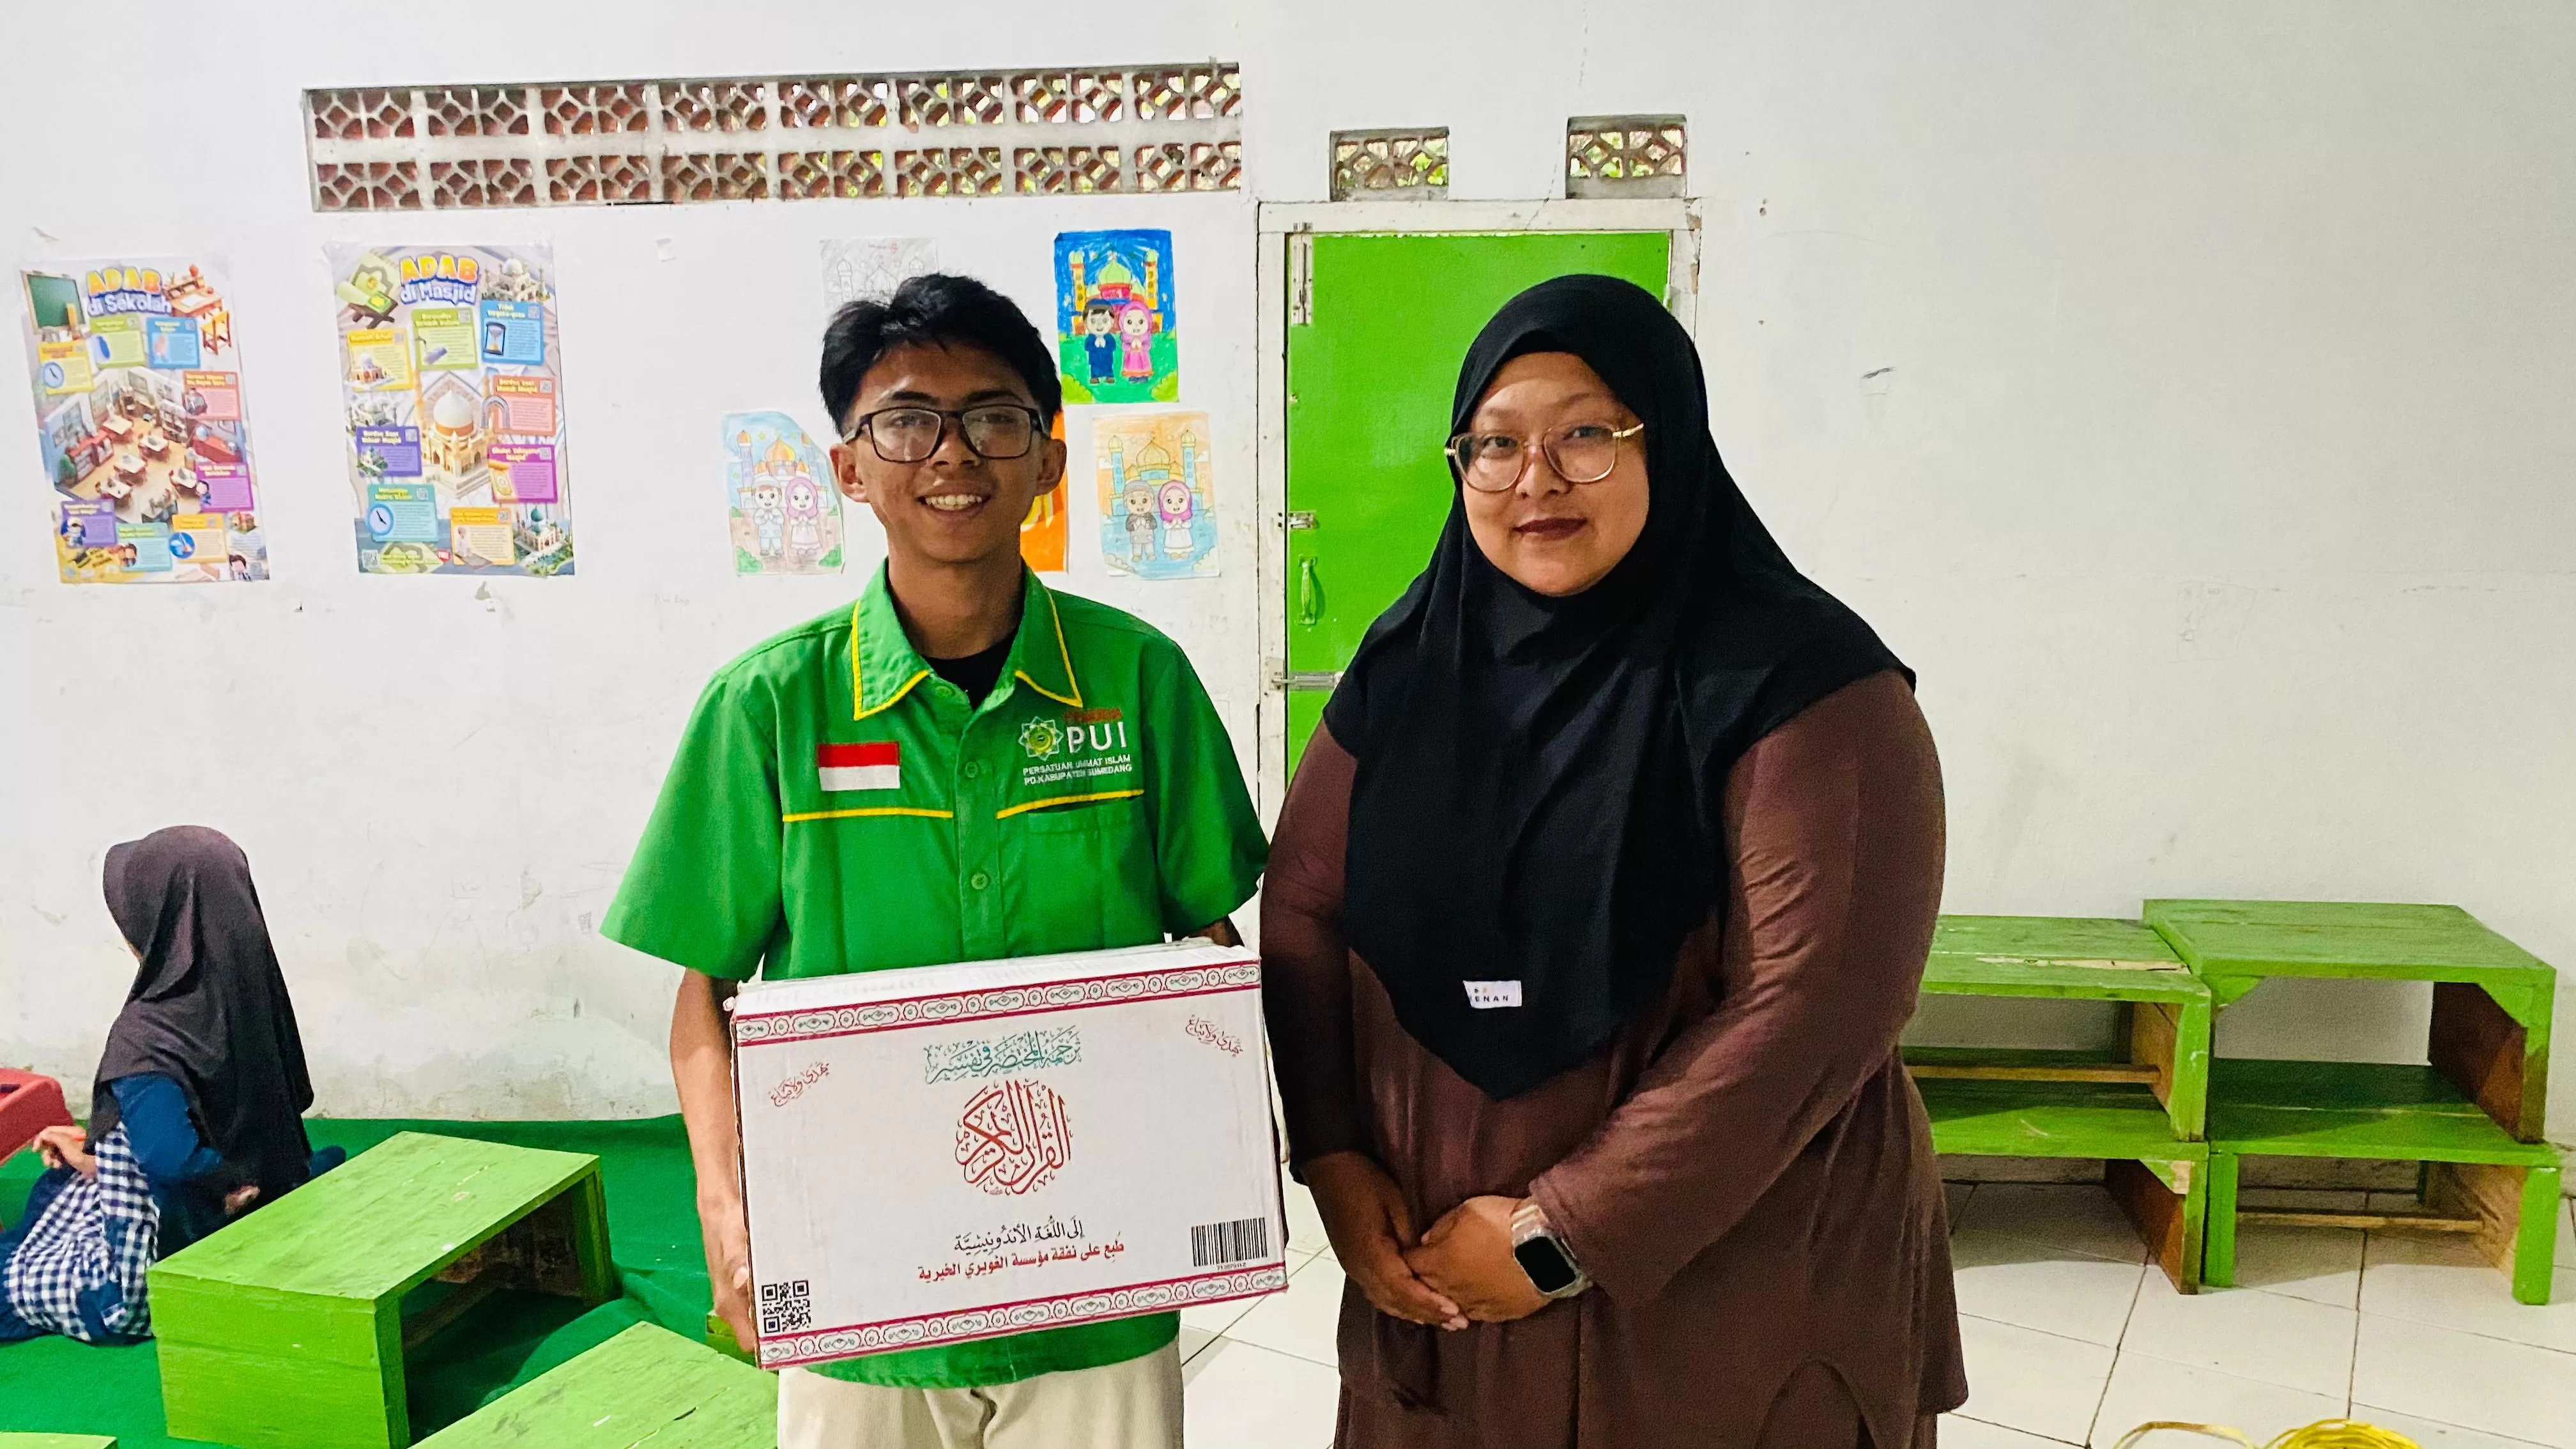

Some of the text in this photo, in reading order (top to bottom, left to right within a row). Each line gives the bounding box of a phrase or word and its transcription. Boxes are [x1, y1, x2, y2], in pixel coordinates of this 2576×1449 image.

[401, 254, 478, 284] ADAB
[87, 267, 162, 296] ADAB
[88, 293, 171, 316] di Sekolah
[401, 282, 476, 305] di Masjid
[1066, 721, 1126, 754] PUI
[1022, 761, 1073, 776] PERSATUAN
[1105, 753, 1131, 765] ISLAM
[1087, 764, 1132, 777] SUMEDANG
[1012, 1250, 1049, 1268] مؤسسة
[1052, 1245, 1077, 1261] نفقة
[1080, 1243, 1101, 1262] على
[917, 1262, 961, 1284] الخيرية
[965, 1254, 1008, 1279] الغويري
